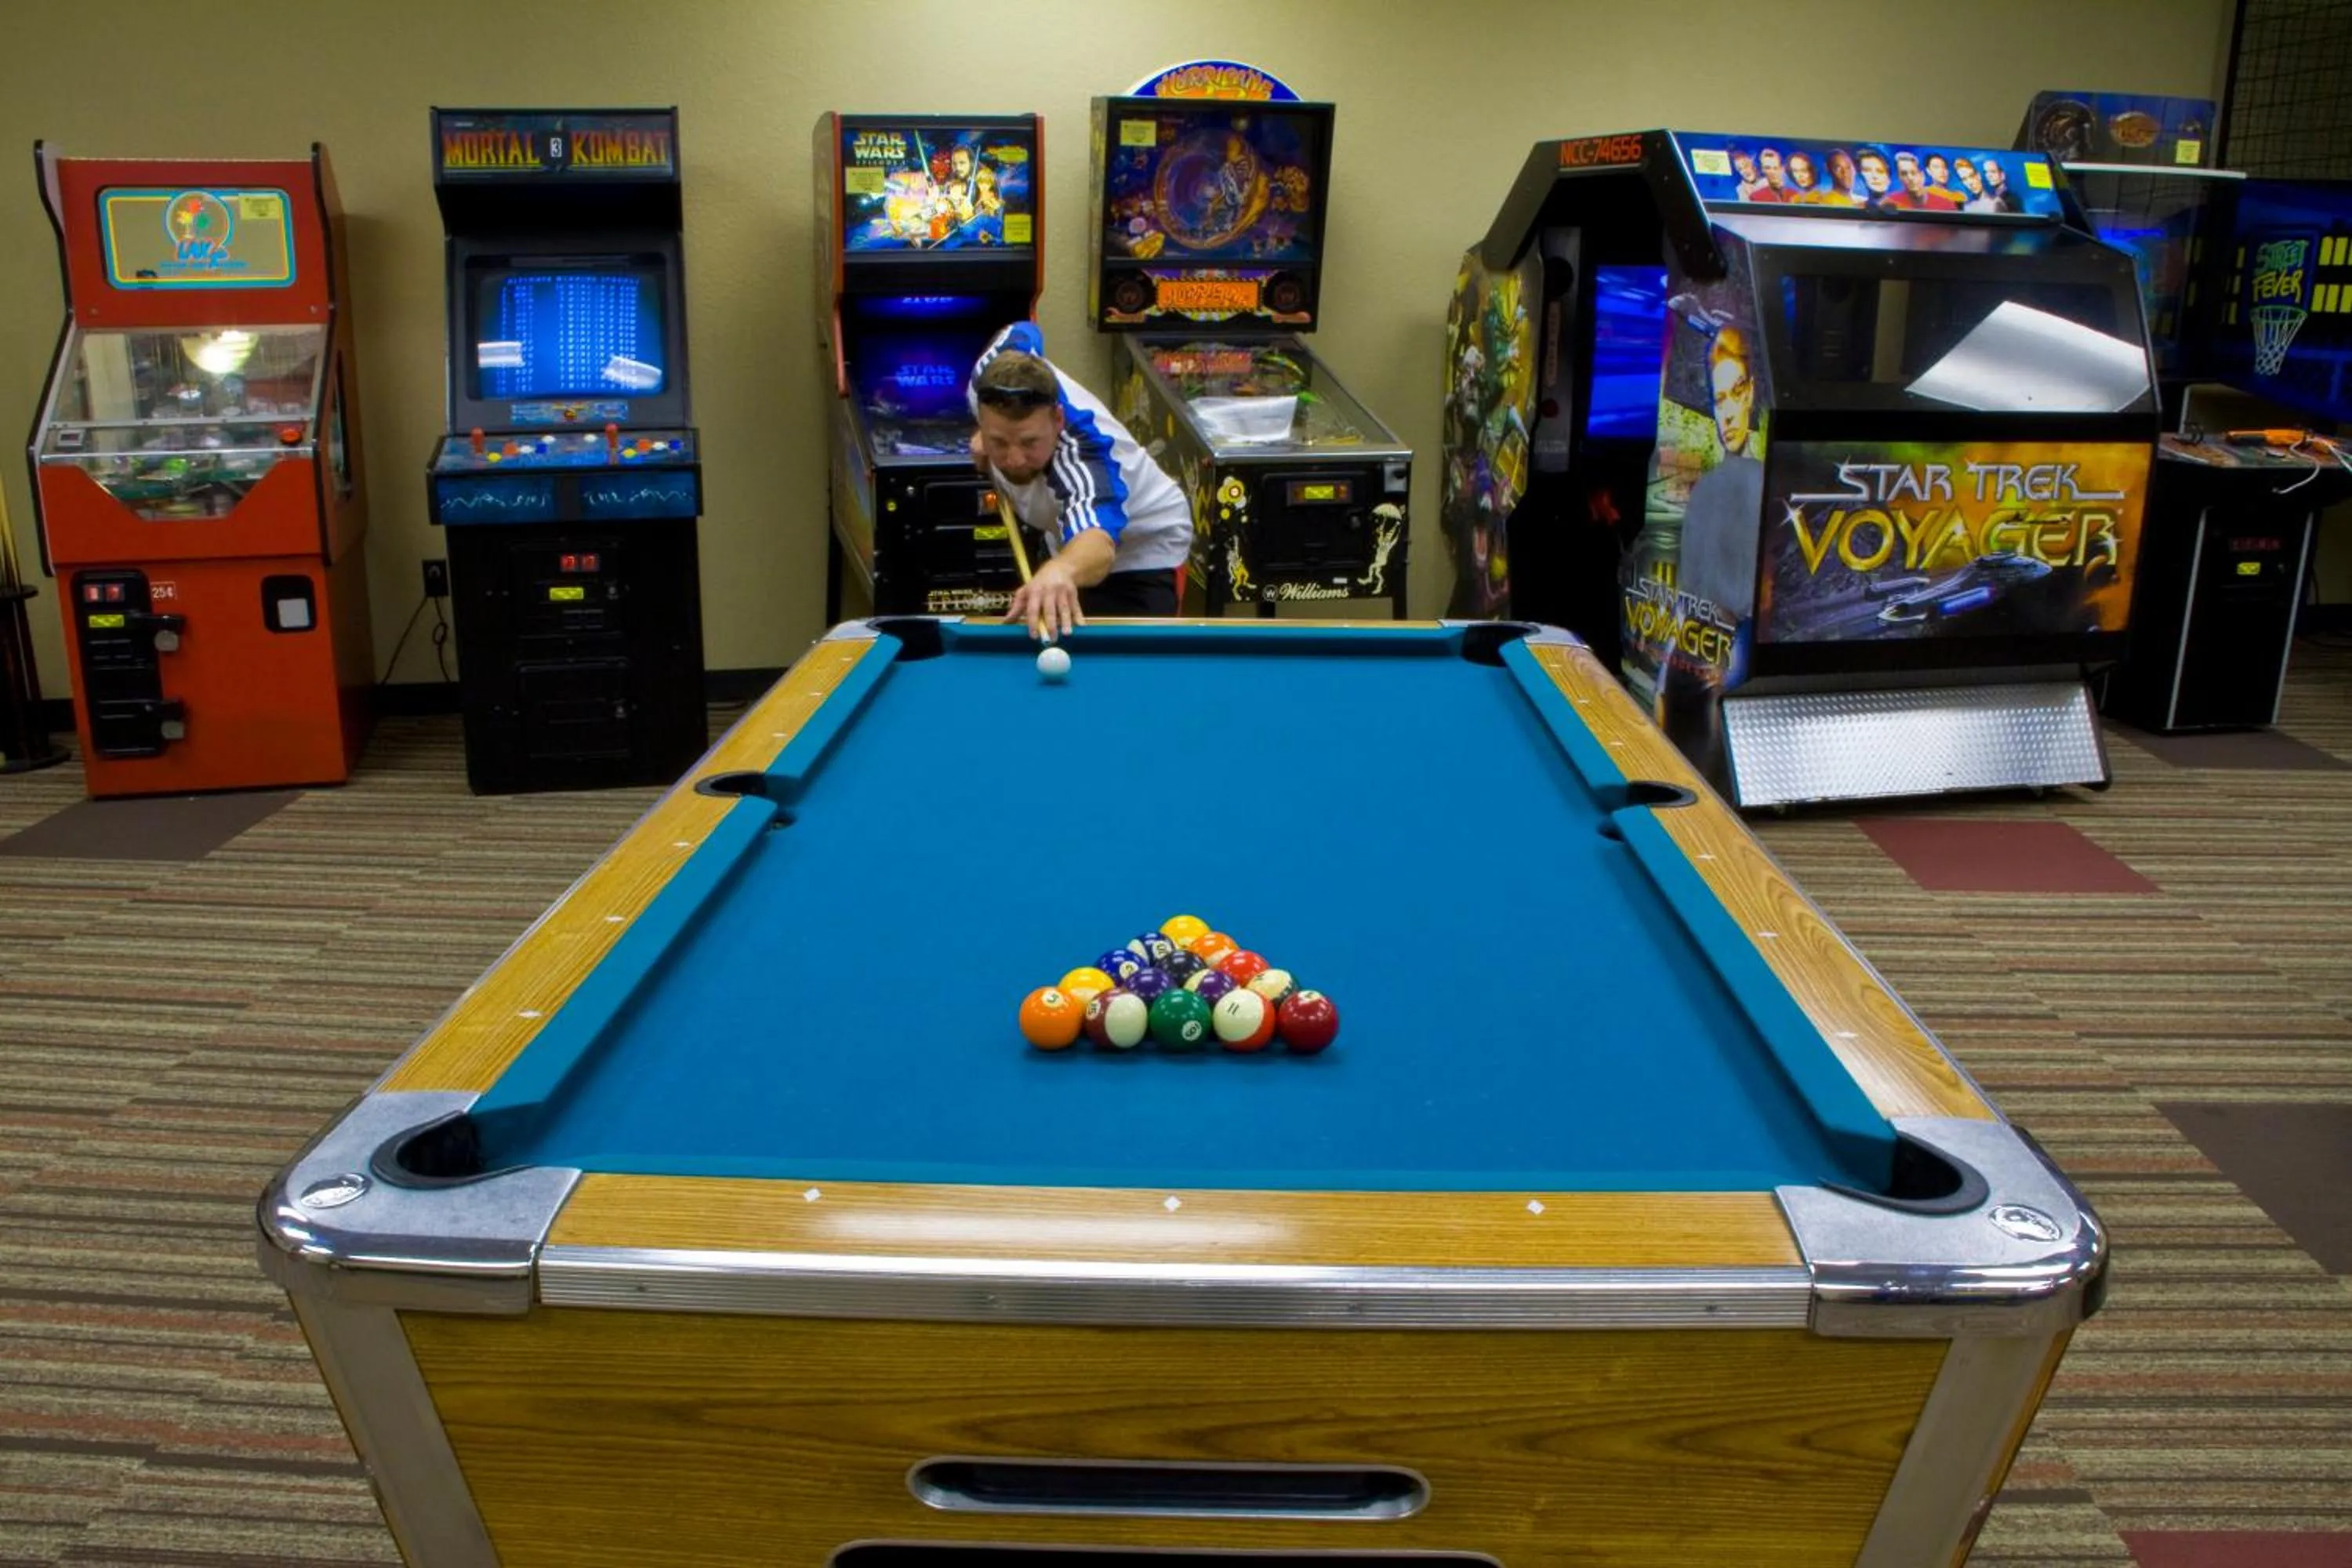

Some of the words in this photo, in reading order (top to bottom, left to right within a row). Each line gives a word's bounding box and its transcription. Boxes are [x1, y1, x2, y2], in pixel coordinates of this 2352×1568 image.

[444, 130, 541, 167] MORTAL
[551, 139, 561, 156] 3
[571, 130, 669, 167] KOMBAT
[853, 145, 906, 159] WARS
[854, 132, 906, 146] STAR
[1559, 136, 1642, 165] NCC-74656
[2256, 240, 2309, 274] STREET
[2252, 269, 2303, 303] FEVER
[896, 376, 954, 387] WARS
[1791, 464, 1954, 502] STAR
[1968, 464, 2125, 502] TREK
[1788, 508, 2119, 575] VOYAGER
[1279, 583, 1348, 601] Williams
[1626, 577, 1674, 604] STAR
[1678, 590, 1735, 631] TREK
[1624, 594, 1733, 671] VOYAGER
[1227, 1002, 1240, 1015] 11
